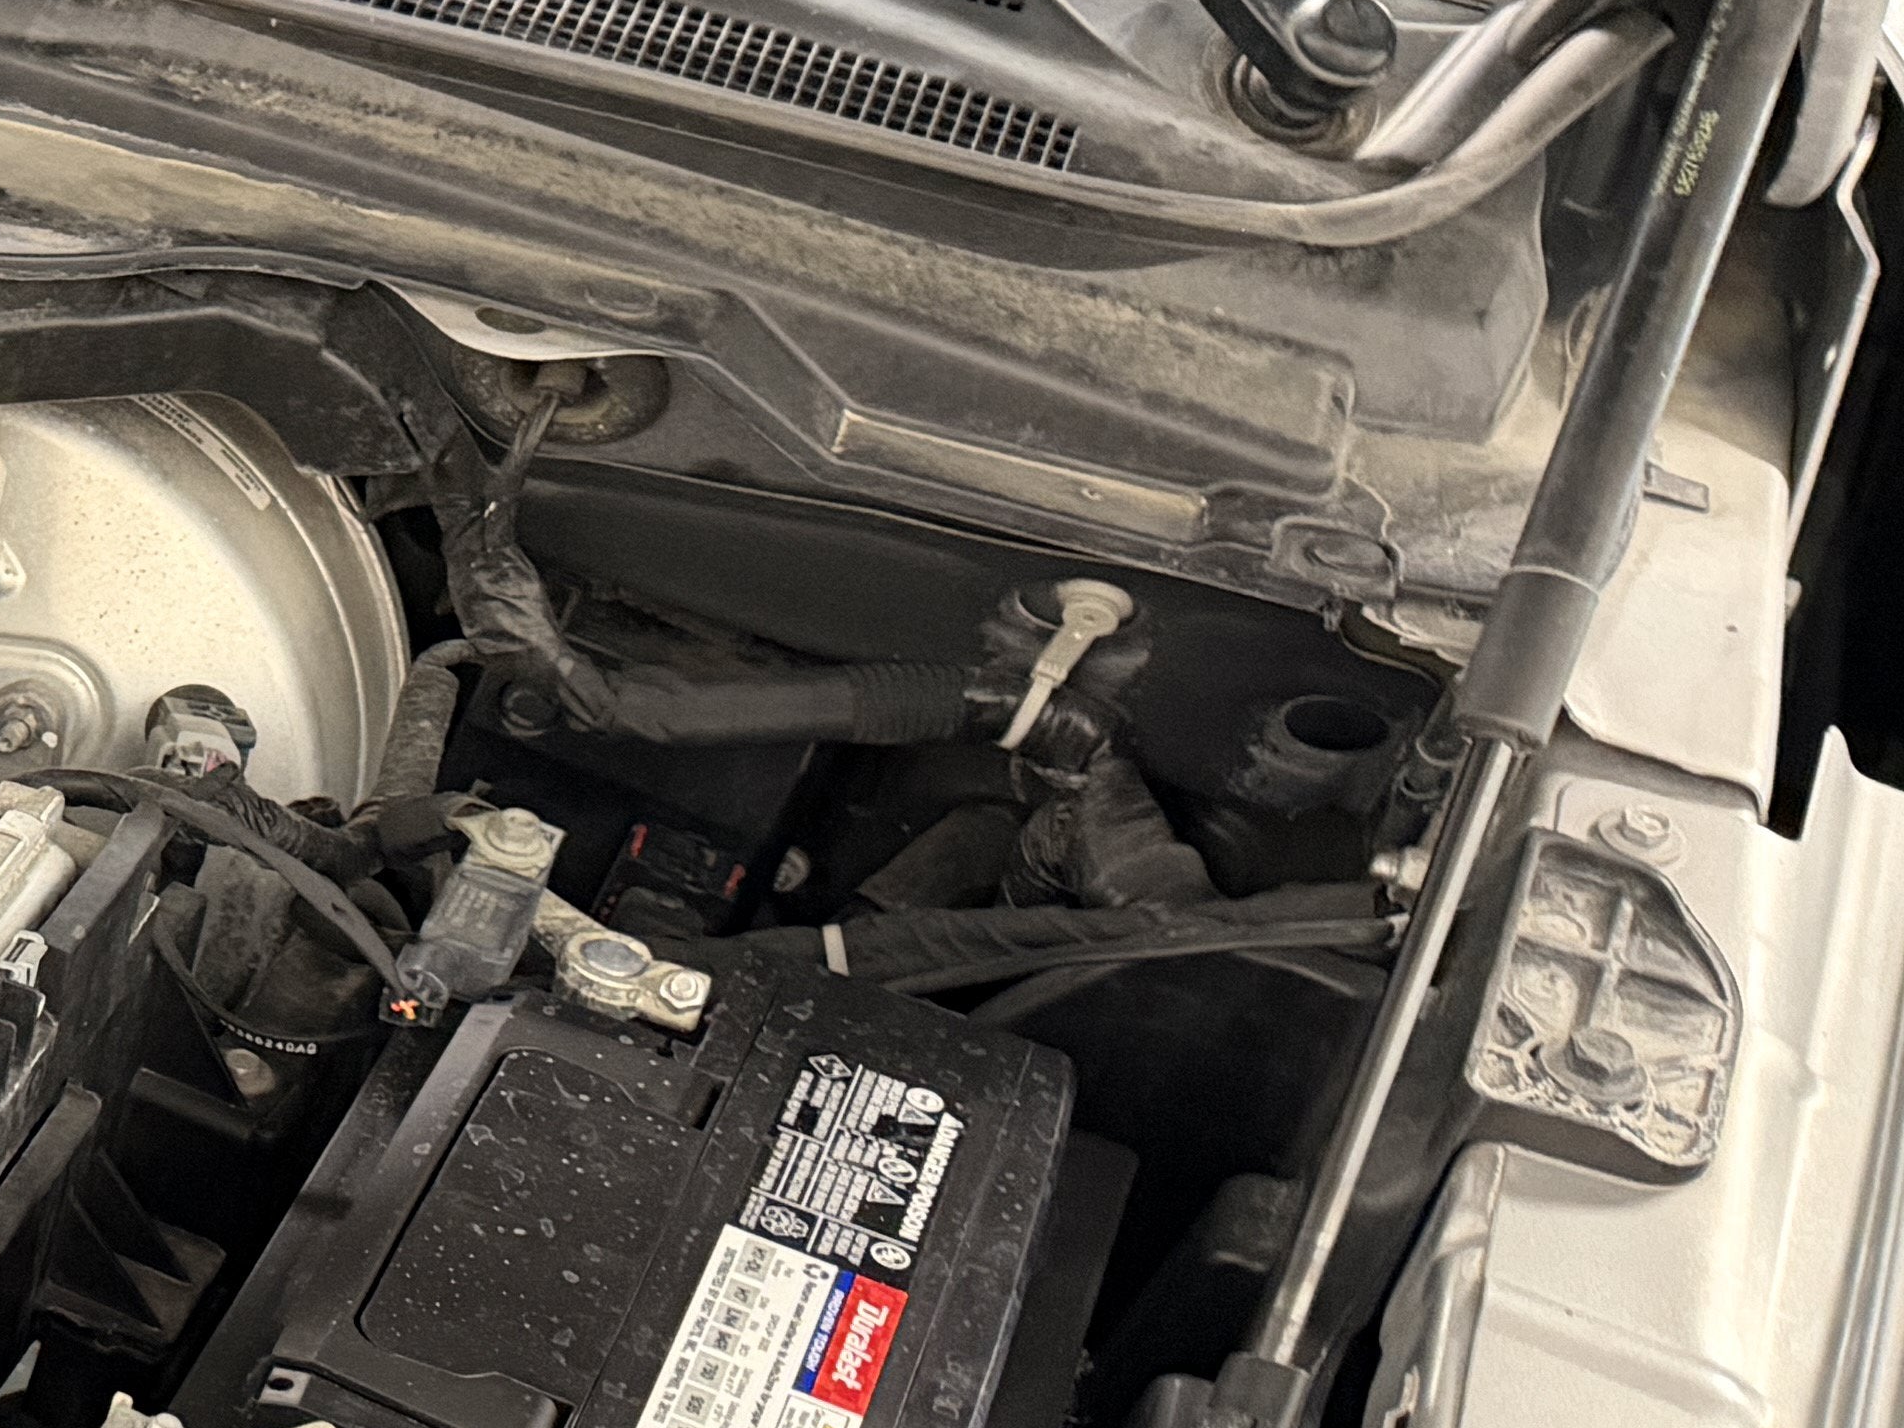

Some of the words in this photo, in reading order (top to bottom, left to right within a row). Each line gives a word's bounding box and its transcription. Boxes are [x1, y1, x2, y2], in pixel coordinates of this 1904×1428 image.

[817, 1287, 847, 1334] PROVEN
[802, 1331, 829, 1372] TOUGH
[829, 1299, 890, 1390] Duralast
